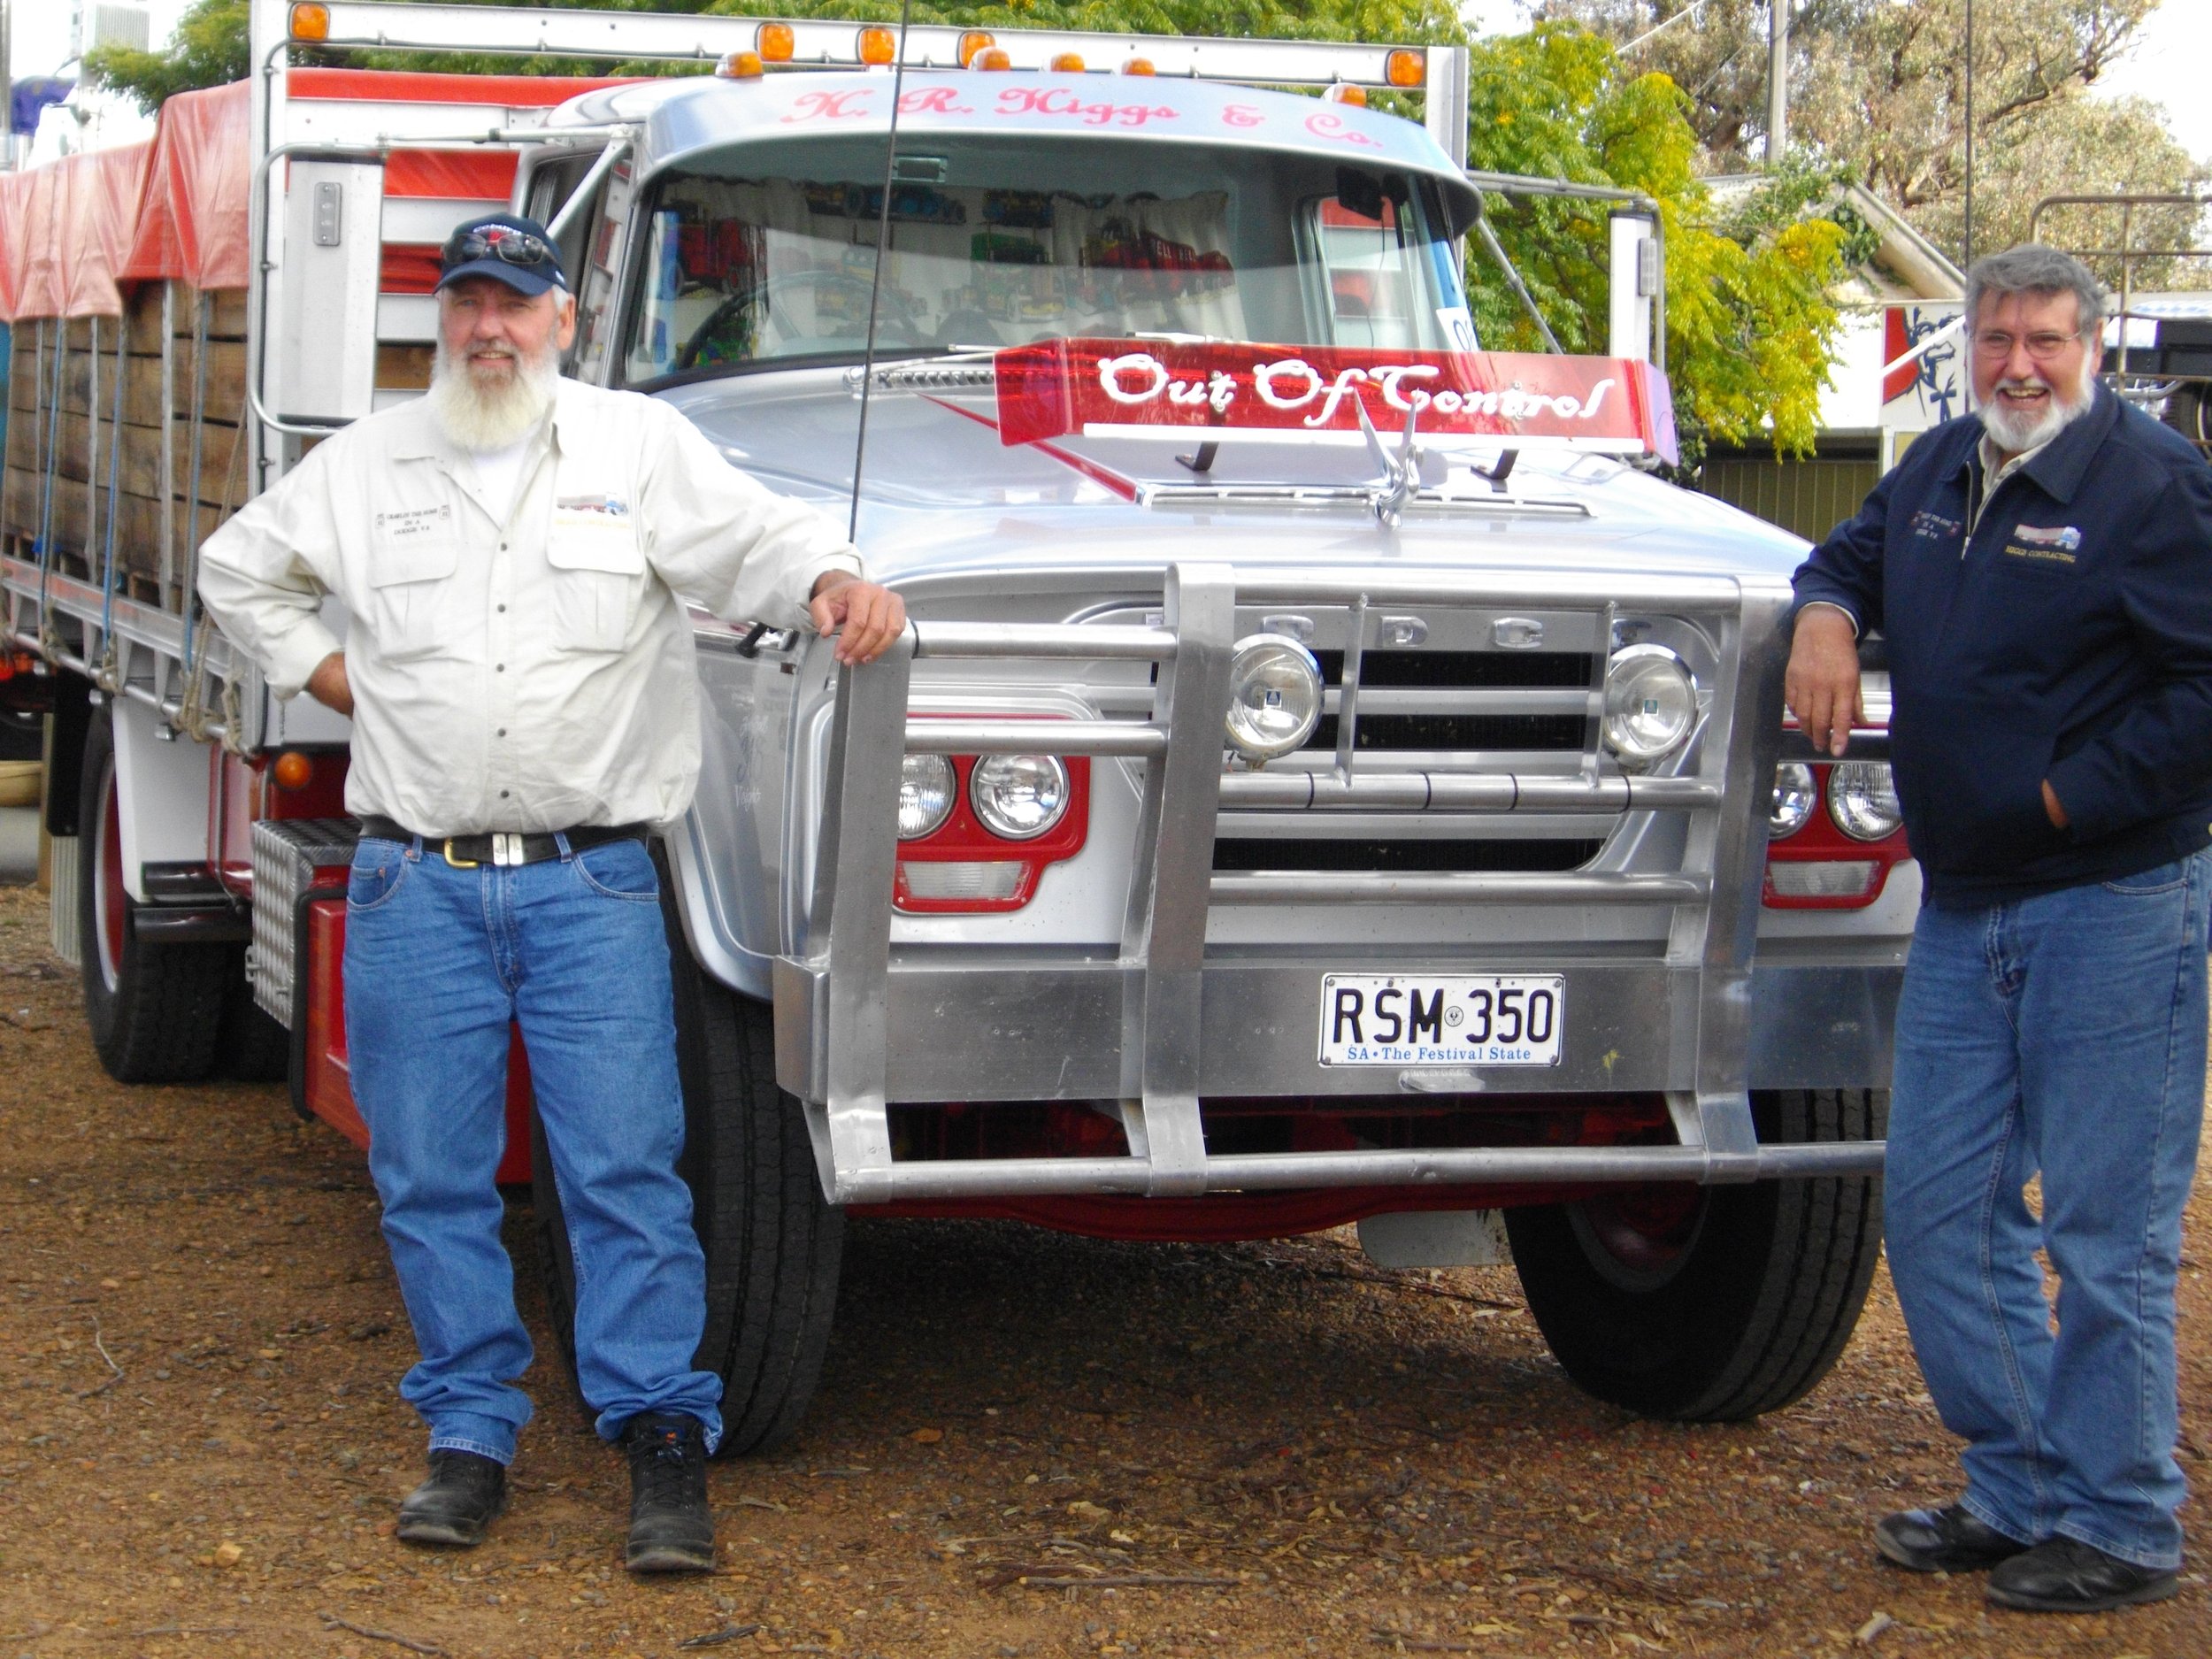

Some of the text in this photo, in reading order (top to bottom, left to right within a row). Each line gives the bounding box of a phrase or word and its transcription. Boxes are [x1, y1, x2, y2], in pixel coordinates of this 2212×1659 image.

[898, 87, 975, 114] R.
[994, 88, 1180, 126] Higgs
[1222, 104, 1265, 127] &
[1303, 113, 1384, 148] Co.
[1097, 353, 1616, 426] Out Of Control
[1333, 988, 1554, 1043] RSM 350
[1382, 1047, 1411, 1060] The
[1418, 1047, 1483, 1060] Festival
[1488, 1047, 1531, 1060] State
